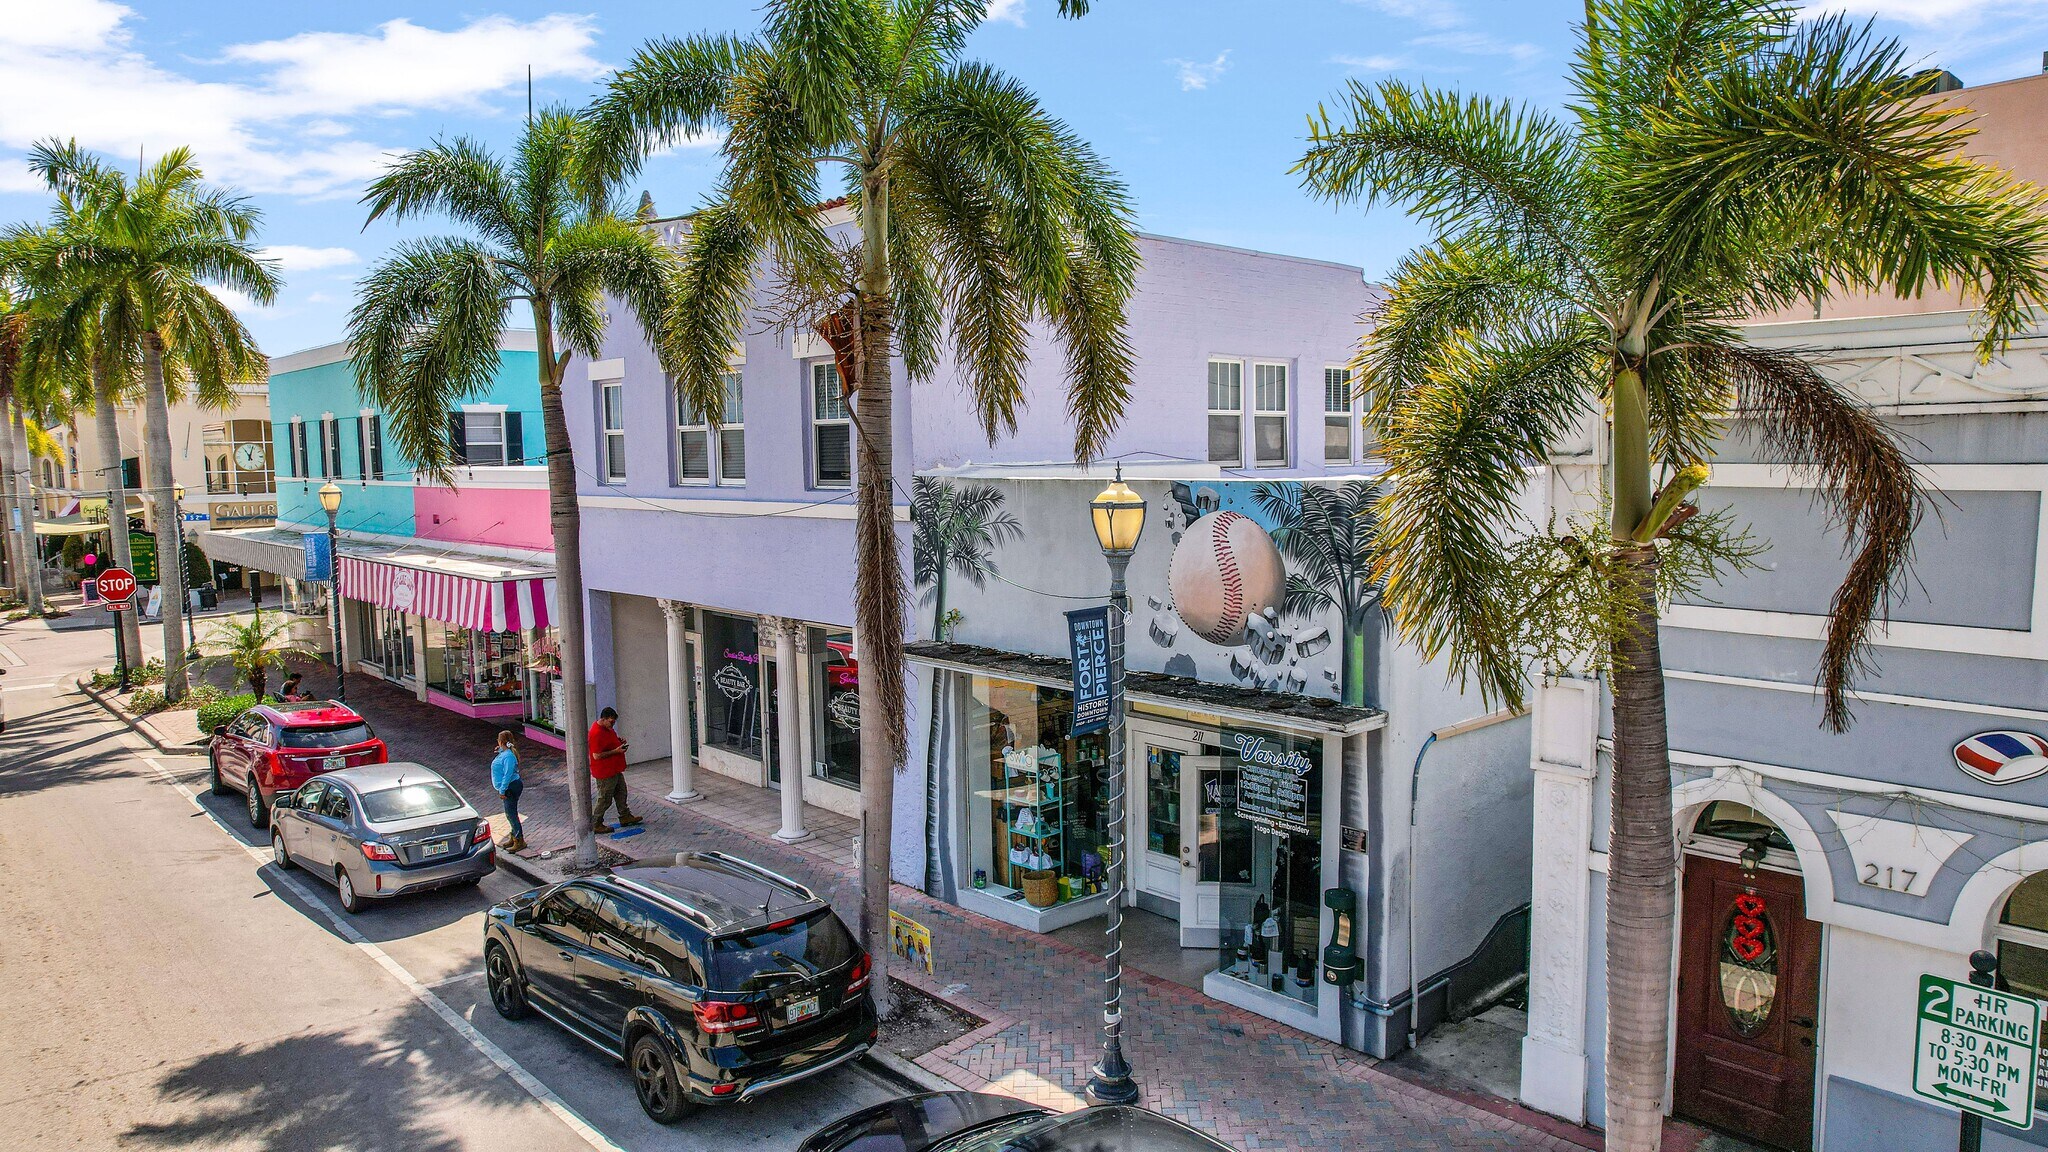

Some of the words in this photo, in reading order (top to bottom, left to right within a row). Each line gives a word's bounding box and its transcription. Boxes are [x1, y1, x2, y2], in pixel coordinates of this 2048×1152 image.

[216, 504, 277, 517] GALLER
[100, 578, 133, 592] STOP
[1074, 619, 1104, 631] DOWNTOWN
[1093, 628, 1108, 696] PIERCE
[720, 677, 736, 686] BEAUTY
[1077, 646, 1092, 700] FORT
[1077, 699, 1109, 712] HISTORIC
[1077, 706, 1109, 719] DOWNTOWN
[1192, 730, 1204, 742] 211
[1234, 733, 1312, 776] Varsity
[1257, 825, 1270, 834] Logo
[1271, 828, 1290, 839] Design
[1279, 821, 1310, 836] Embroidery
[1863, 863, 1917, 891] 217
[1924, 985, 1950, 1018] 2
[1978, 994, 2008, 1015] HR
[1955, 1007, 2029, 1041] PARKING
[1941, 1028, 1976, 1051] 8:30
[1984, 1041, 2008, 1061] AM
[1928, 1042, 1947, 1061] TO
[1954, 1050, 1989, 1073] 5:30
[1996, 1062, 2020, 1083] PM
[1937, 1063, 2007, 1098] MON-FRI
